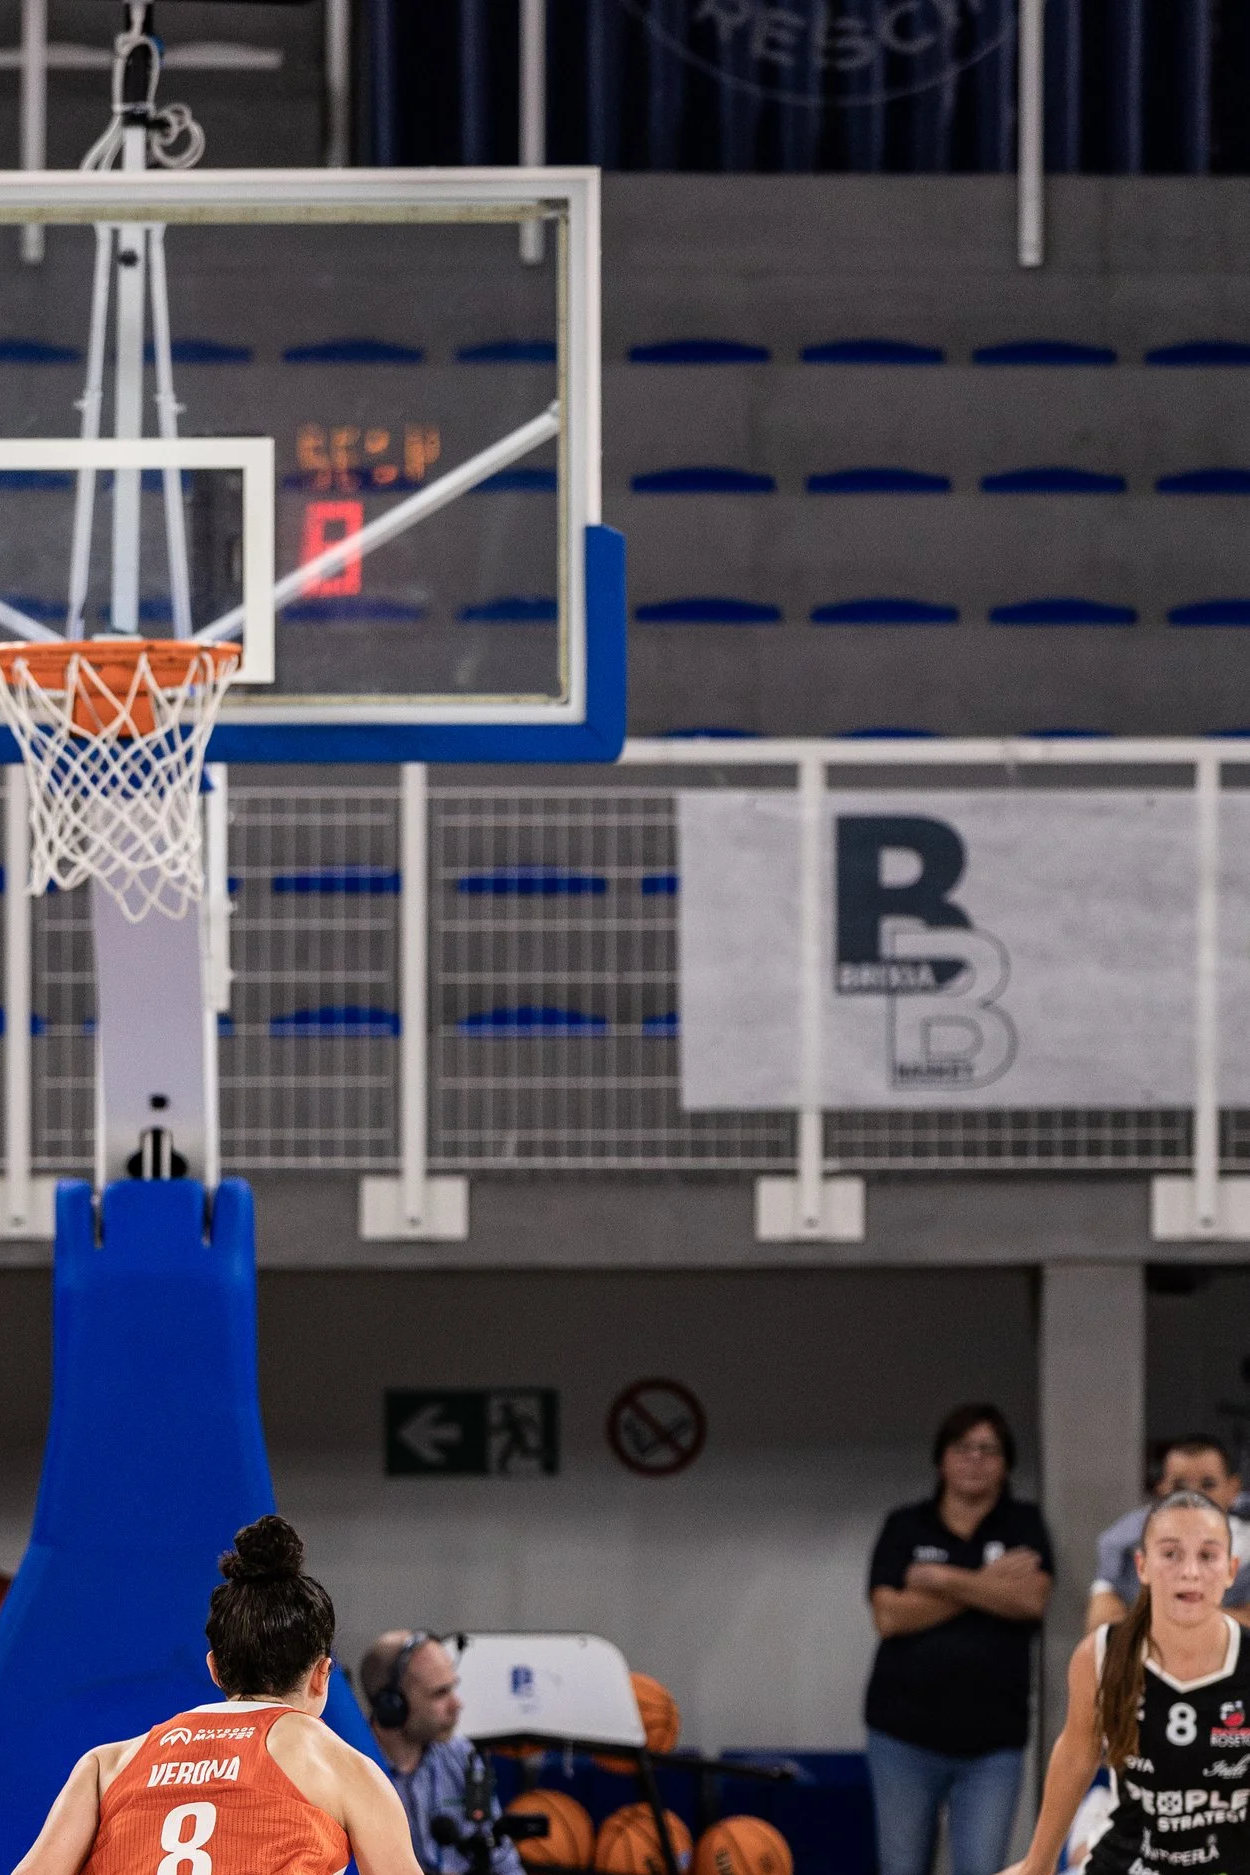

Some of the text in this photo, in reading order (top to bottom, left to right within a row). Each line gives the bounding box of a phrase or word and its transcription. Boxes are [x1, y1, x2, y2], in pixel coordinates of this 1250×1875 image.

[198, 1726, 256, 1734] OUTDOOR
[1166, 1702, 1197, 1747] 8
[192, 1731, 254, 1742] MASTER
[147, 1755, 240, 1788] VERONA
